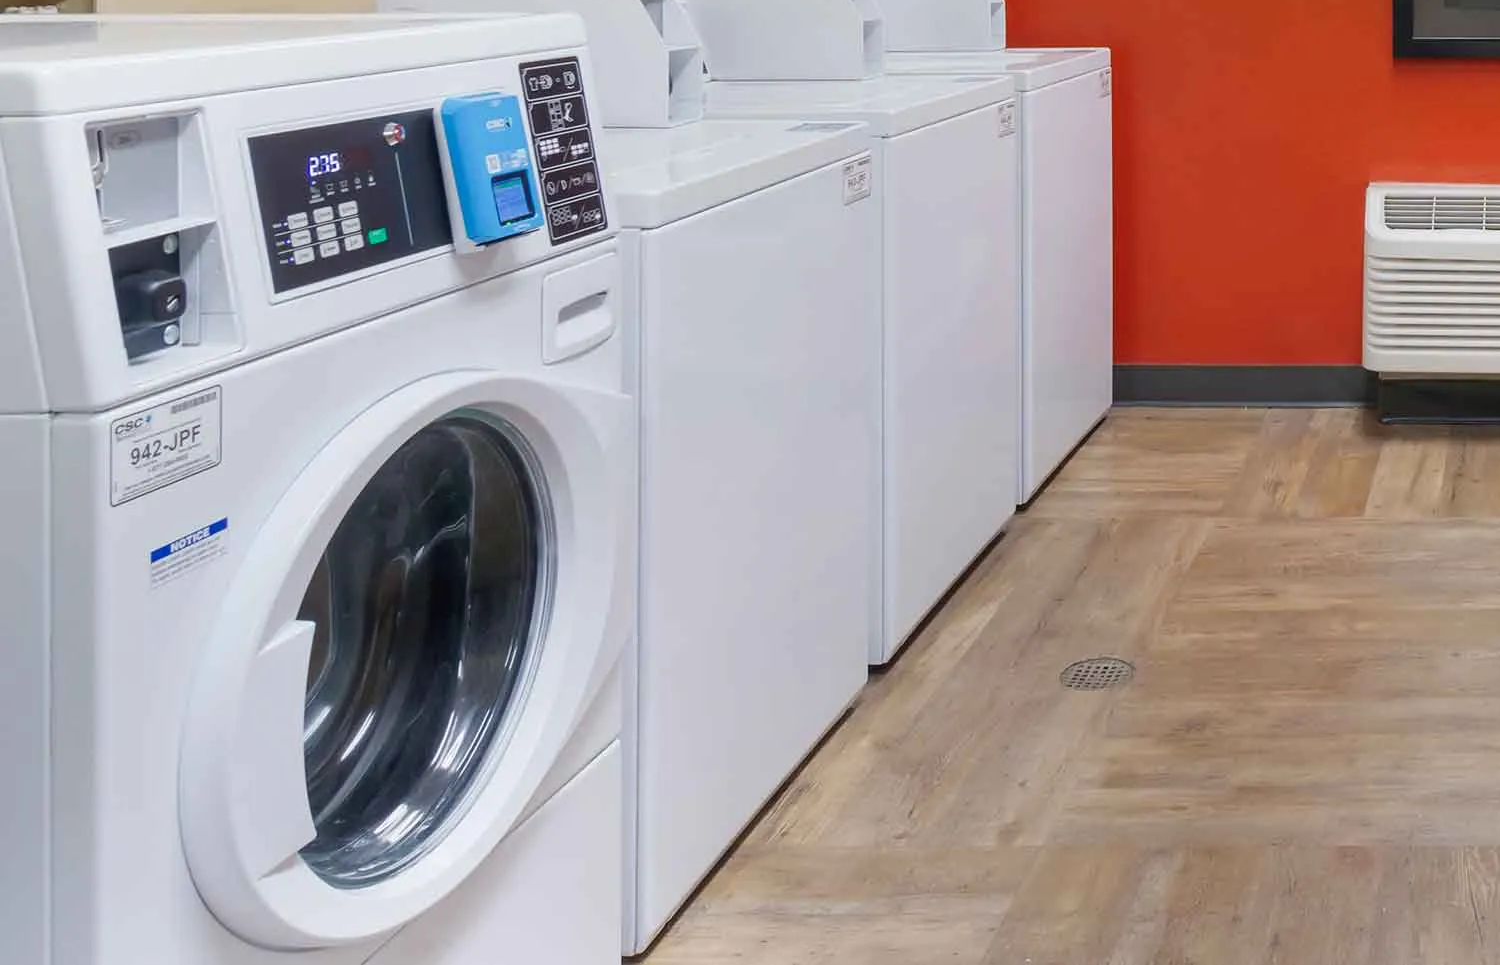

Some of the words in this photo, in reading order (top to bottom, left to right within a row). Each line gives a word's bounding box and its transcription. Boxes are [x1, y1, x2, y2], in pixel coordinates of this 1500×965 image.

[114, 418, 143, 435] CSC
[130, 424, 201, 466] 942-JPF
[170, 526, 210, 554] NOTICE
